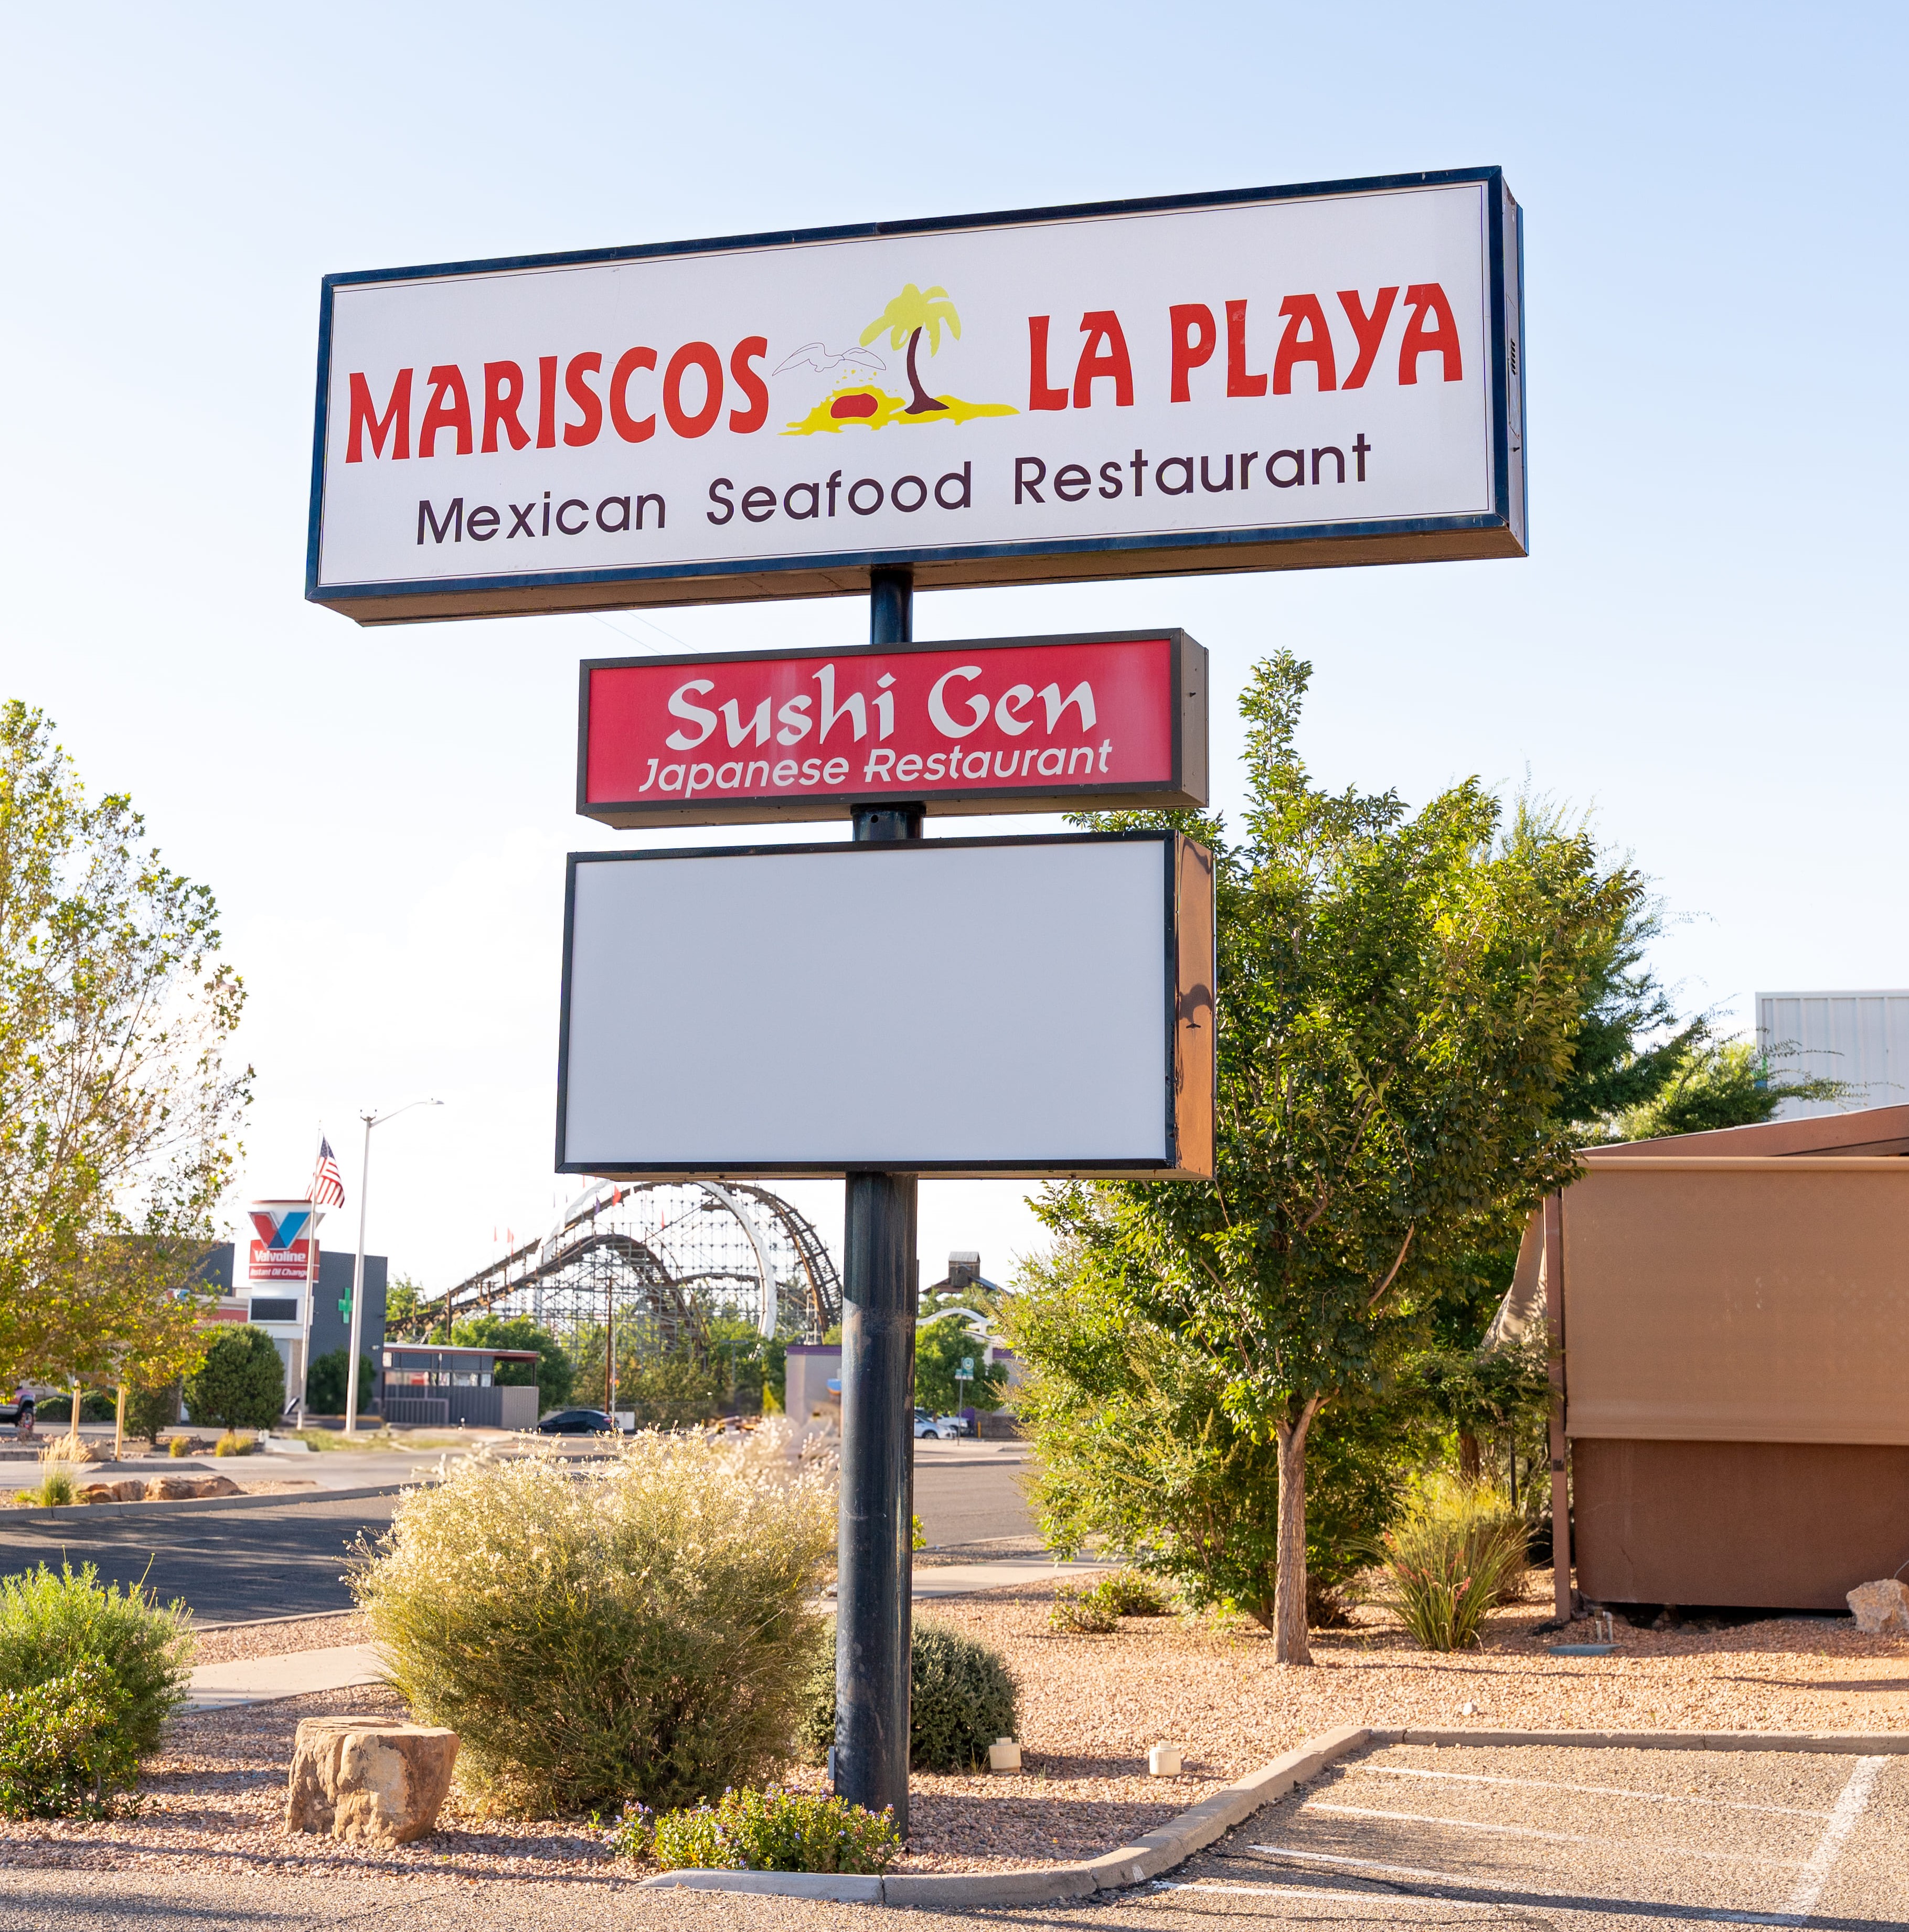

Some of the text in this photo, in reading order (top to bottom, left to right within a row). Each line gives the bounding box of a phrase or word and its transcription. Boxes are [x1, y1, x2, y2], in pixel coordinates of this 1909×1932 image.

[346, 283, 1463, 464] MARISCOS LA PLAYA
[417, 433, 1371, 545] Mexican Seafood Restaurant
[665, 664, 1096, 751] Sushi Gen
[638, 739, 1113, 798] Japanese Restaurant
[254, 1250, 306, 1262] Valvoline
